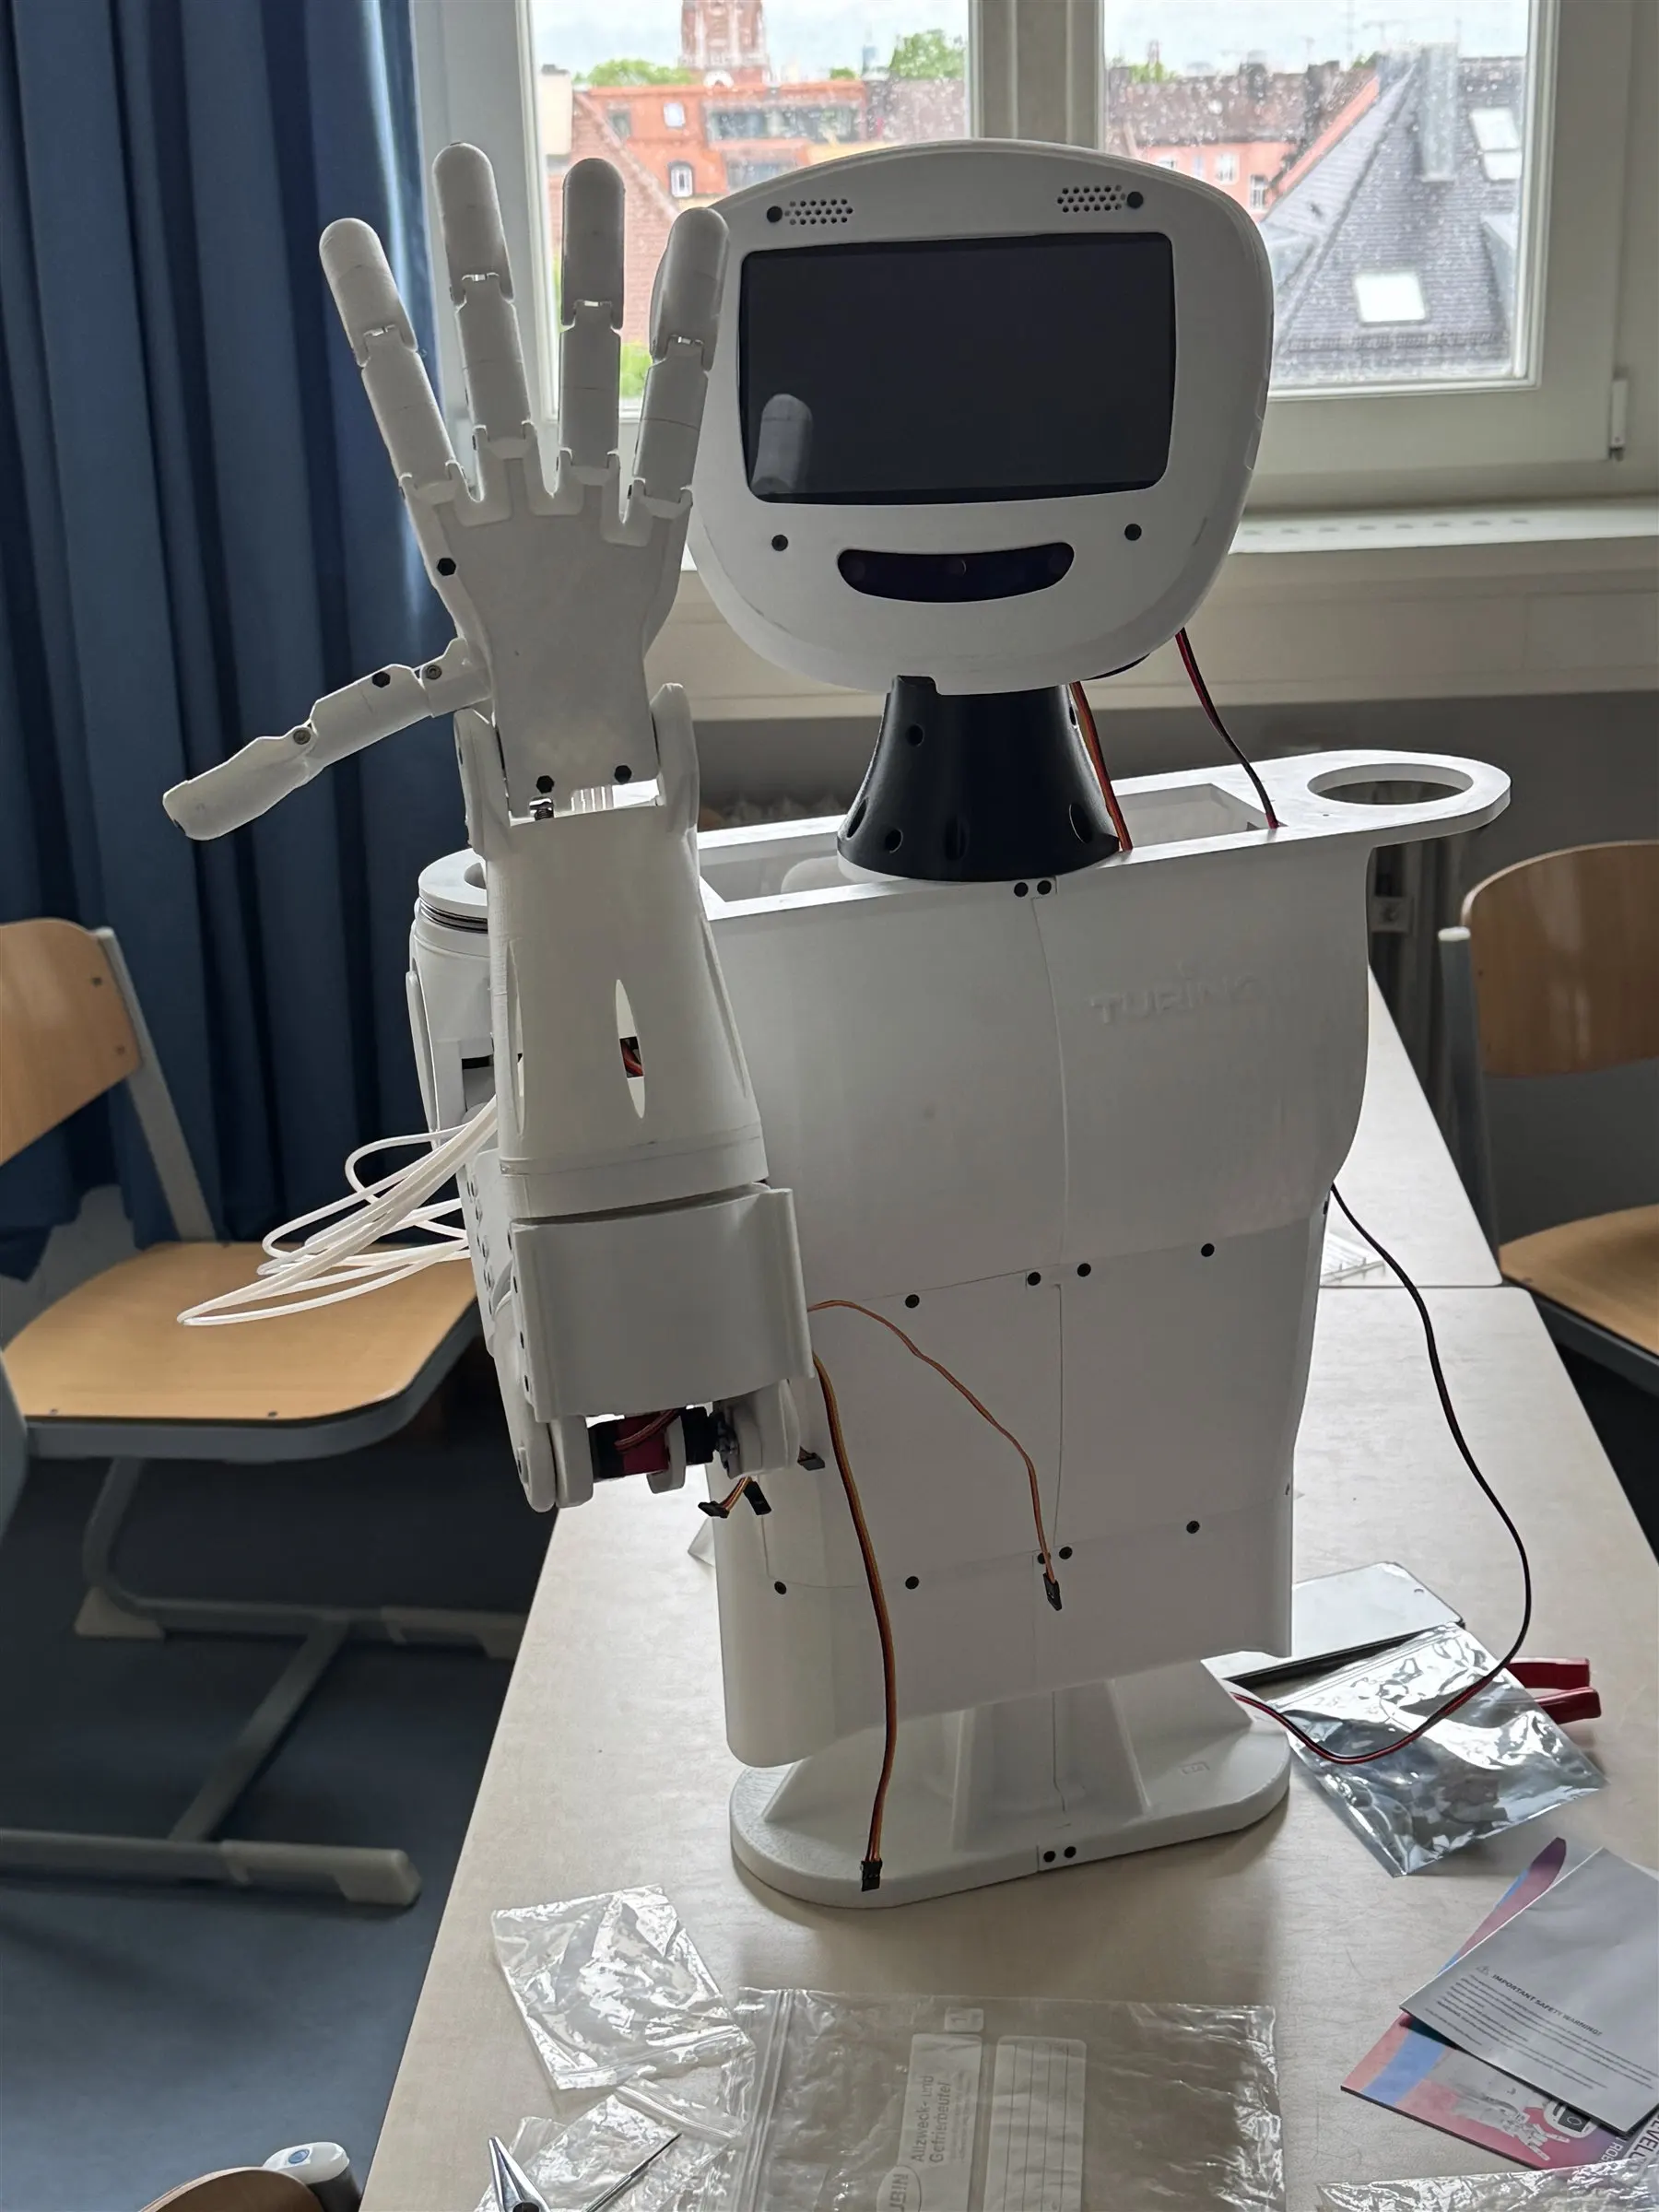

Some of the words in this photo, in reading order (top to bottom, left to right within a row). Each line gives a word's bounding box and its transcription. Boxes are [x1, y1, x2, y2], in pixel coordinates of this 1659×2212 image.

[1491, 1974, 1536, 2001] IMPORTANT
[1535, 1999, 1563, 2017] SAFETY
[911, 2101, 930, 2163] Allzweck-
[921, 2076, 935, 2098] und
[929, 2082, 952, 2163] Gefrierbeutel
[1599, 2141, 1625, 2164] ROB
